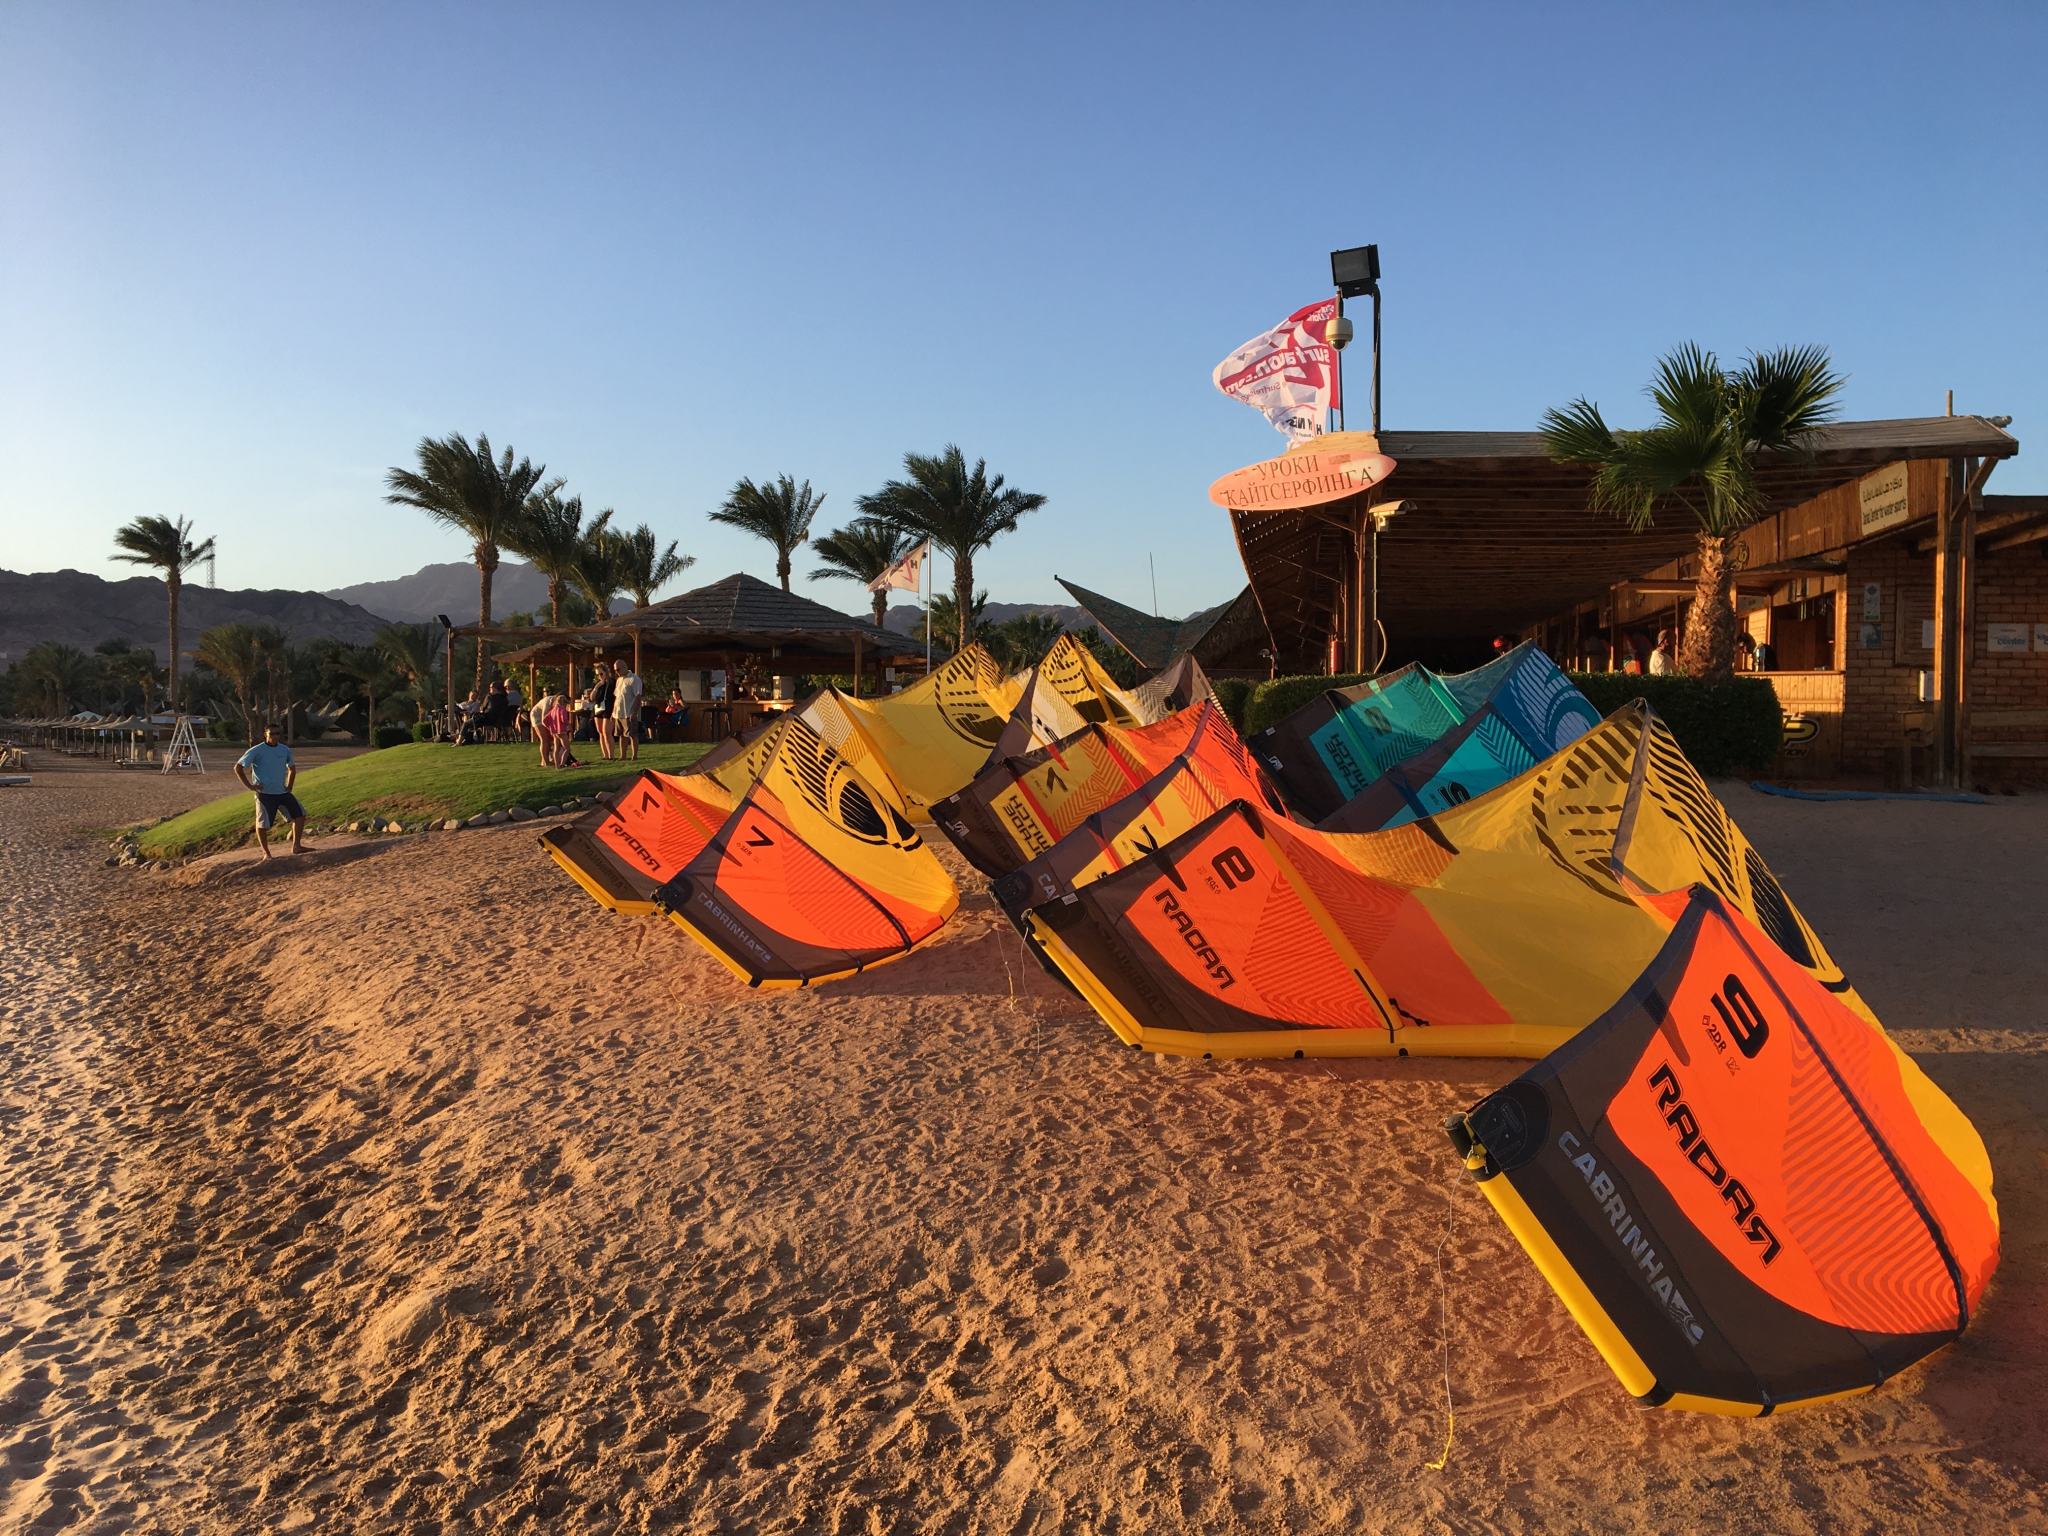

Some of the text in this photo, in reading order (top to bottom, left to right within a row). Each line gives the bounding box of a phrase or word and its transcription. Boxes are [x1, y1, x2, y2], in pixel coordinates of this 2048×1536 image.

[1225, 467, 1375, 506] КАЙТСЕРФИНГА
[1256, 455, 1320, 481] УРОКИ
[1710, 973, 1770, 1059] 9
[1558, 1131, 1674, 1305] CABRINHA
